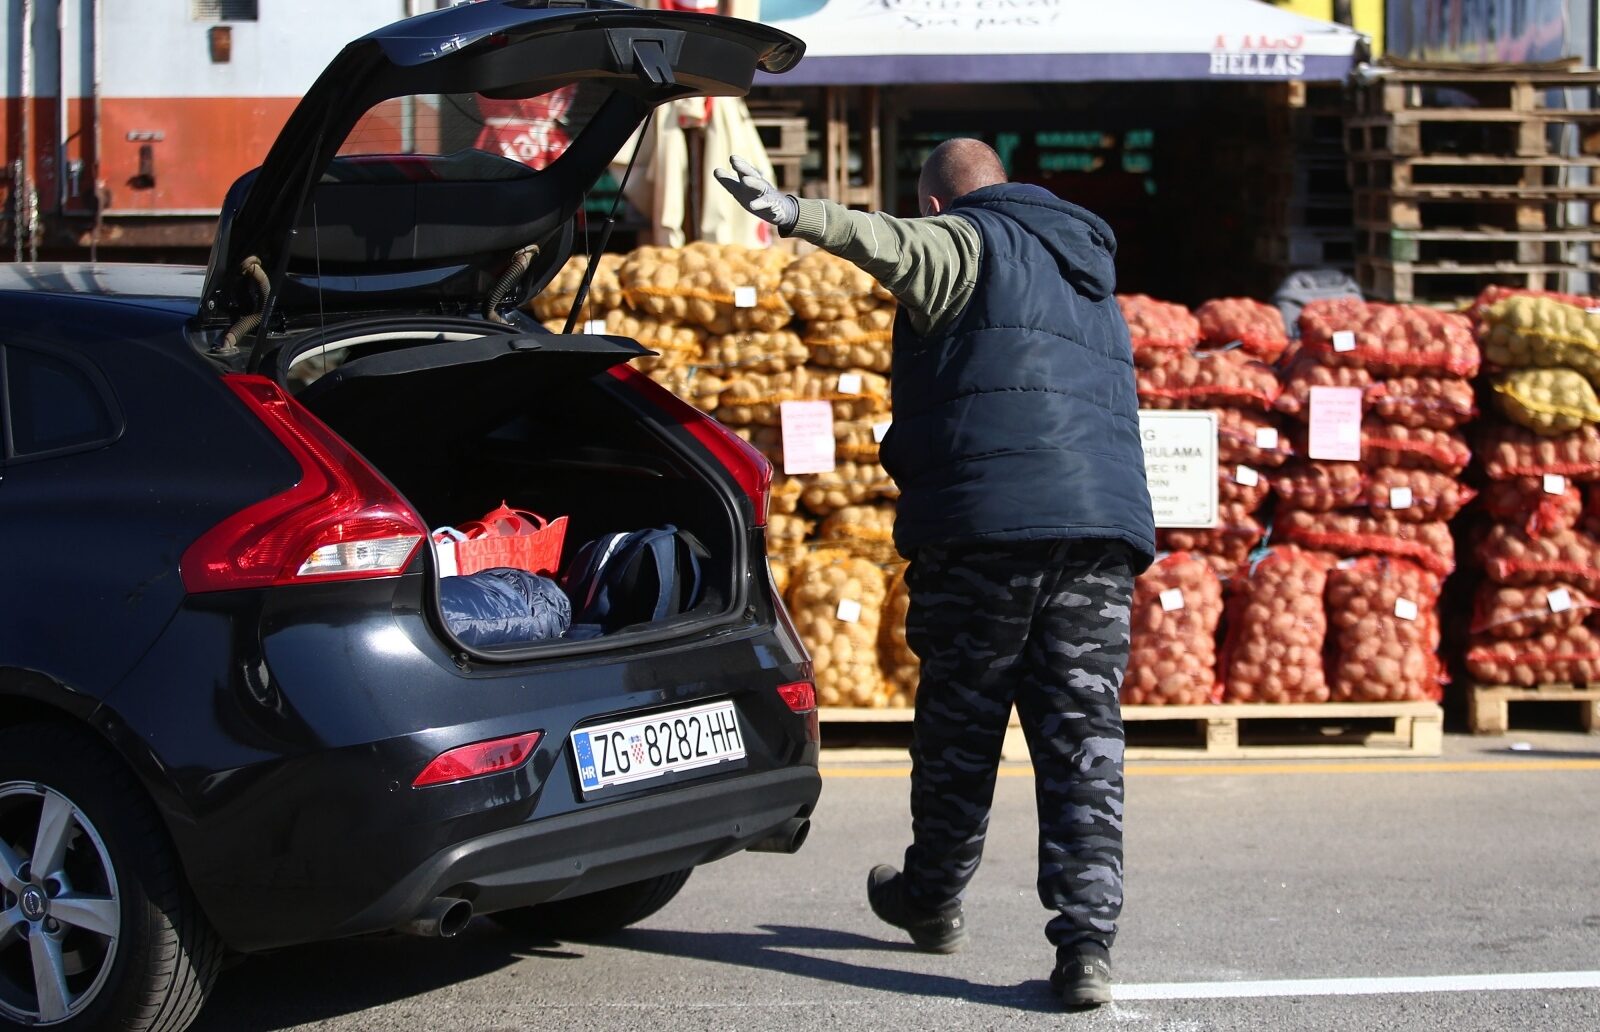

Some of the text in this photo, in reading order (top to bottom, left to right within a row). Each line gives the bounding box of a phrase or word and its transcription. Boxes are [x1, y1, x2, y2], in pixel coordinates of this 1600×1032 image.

[1208, 53, 1305, 76] HELLAS
[594, 731, 631, 778] ZG
[582, 766, 597, 780] HR
